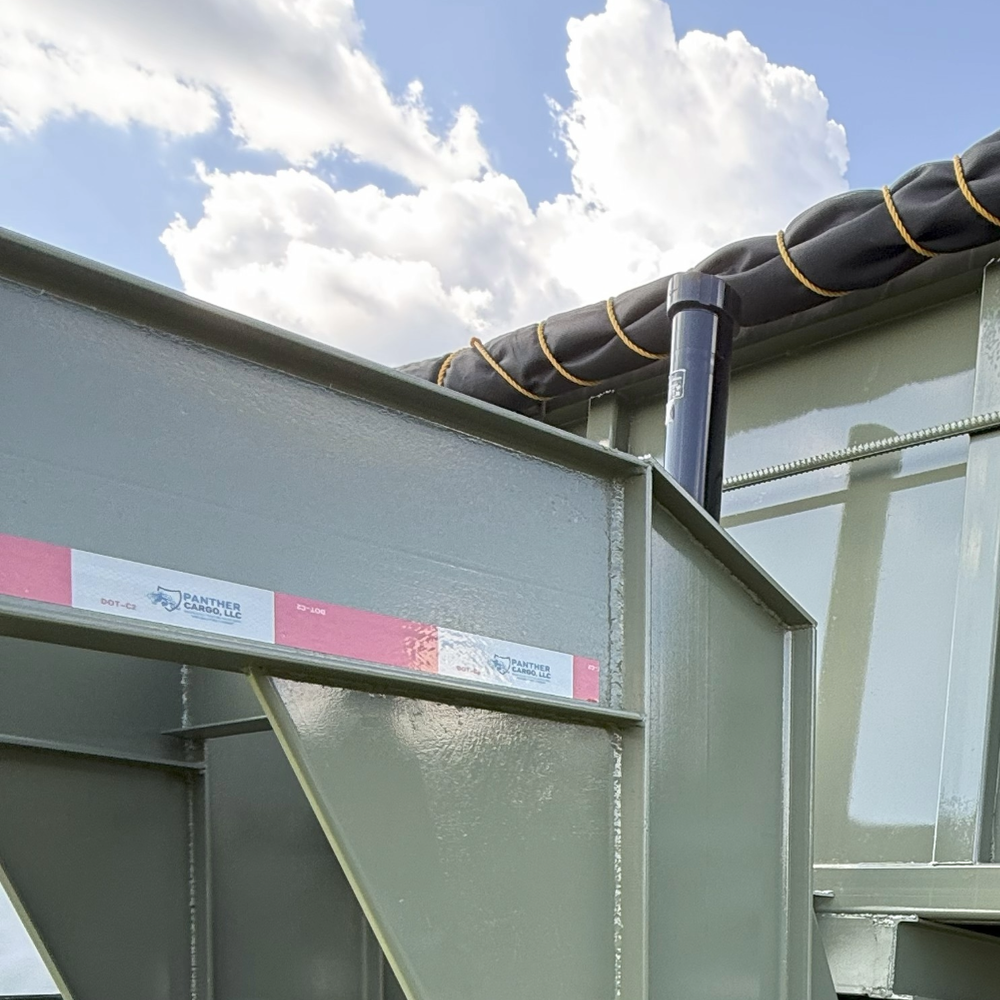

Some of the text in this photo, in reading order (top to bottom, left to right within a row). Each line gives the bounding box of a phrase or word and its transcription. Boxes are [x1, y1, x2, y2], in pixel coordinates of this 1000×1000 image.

[100, 598, 137, 610] DOT-C2
[183, 592, 241, 611] PANTHER
[183, 602, 222, 616] CARGO,
[224, 609, 242, 619] LLC
[296, 603, 326, 615] DOT-C2
[511, 658, 550, 672] PANTHER
[511, 665, 538, 678] CARGO,
[539, 670, 552, 679] LLC
